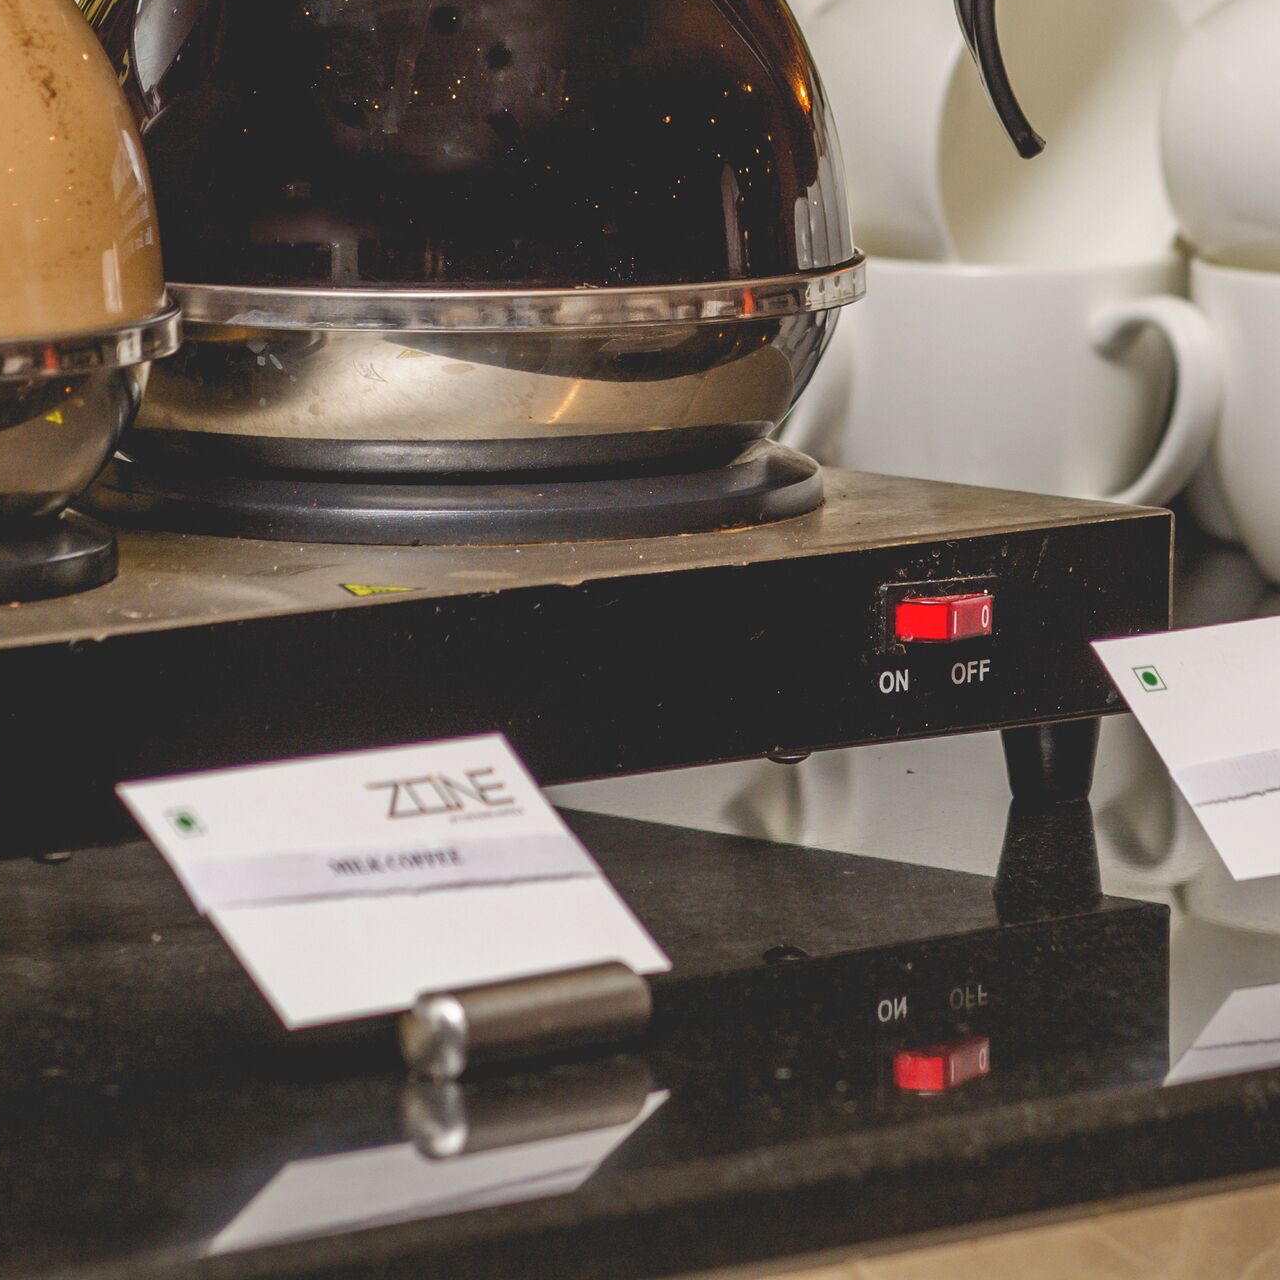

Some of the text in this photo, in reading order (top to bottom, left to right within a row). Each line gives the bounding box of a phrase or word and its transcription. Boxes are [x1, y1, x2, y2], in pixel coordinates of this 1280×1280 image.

[878, 658, 992, 694] ON OFF
[364, 766, 516, 821] ZONE
